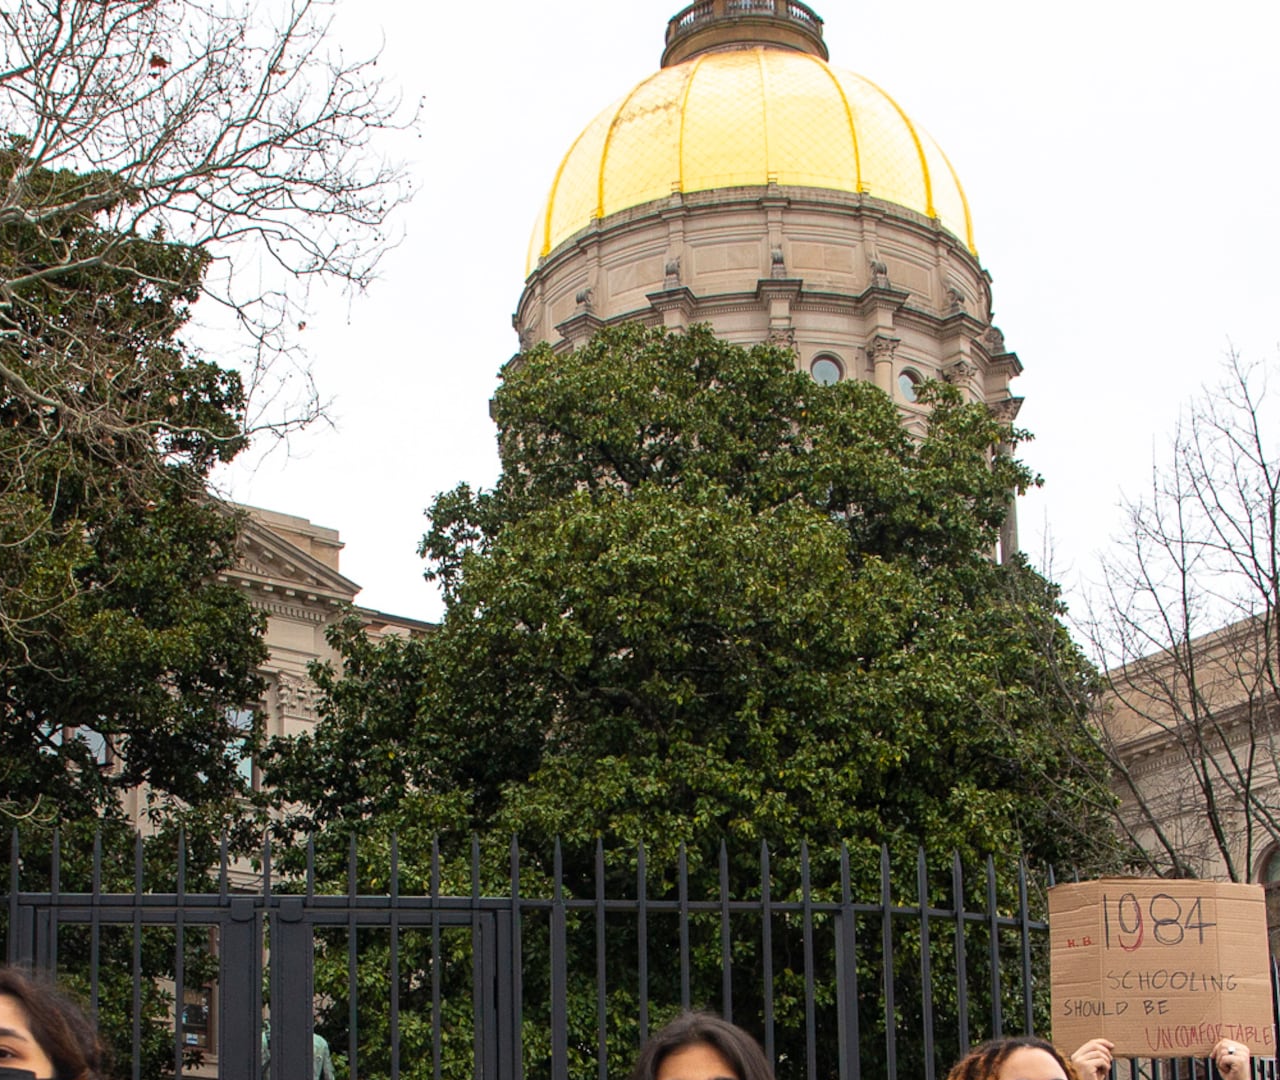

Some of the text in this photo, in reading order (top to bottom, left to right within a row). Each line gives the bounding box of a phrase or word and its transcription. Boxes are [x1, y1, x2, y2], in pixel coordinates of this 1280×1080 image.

[1103, 892, 1217, 952] 1984
[1106, 968, 1238, 992] SCHOOLING
[1063, 999, 1170, 1018] SHOULD BE
